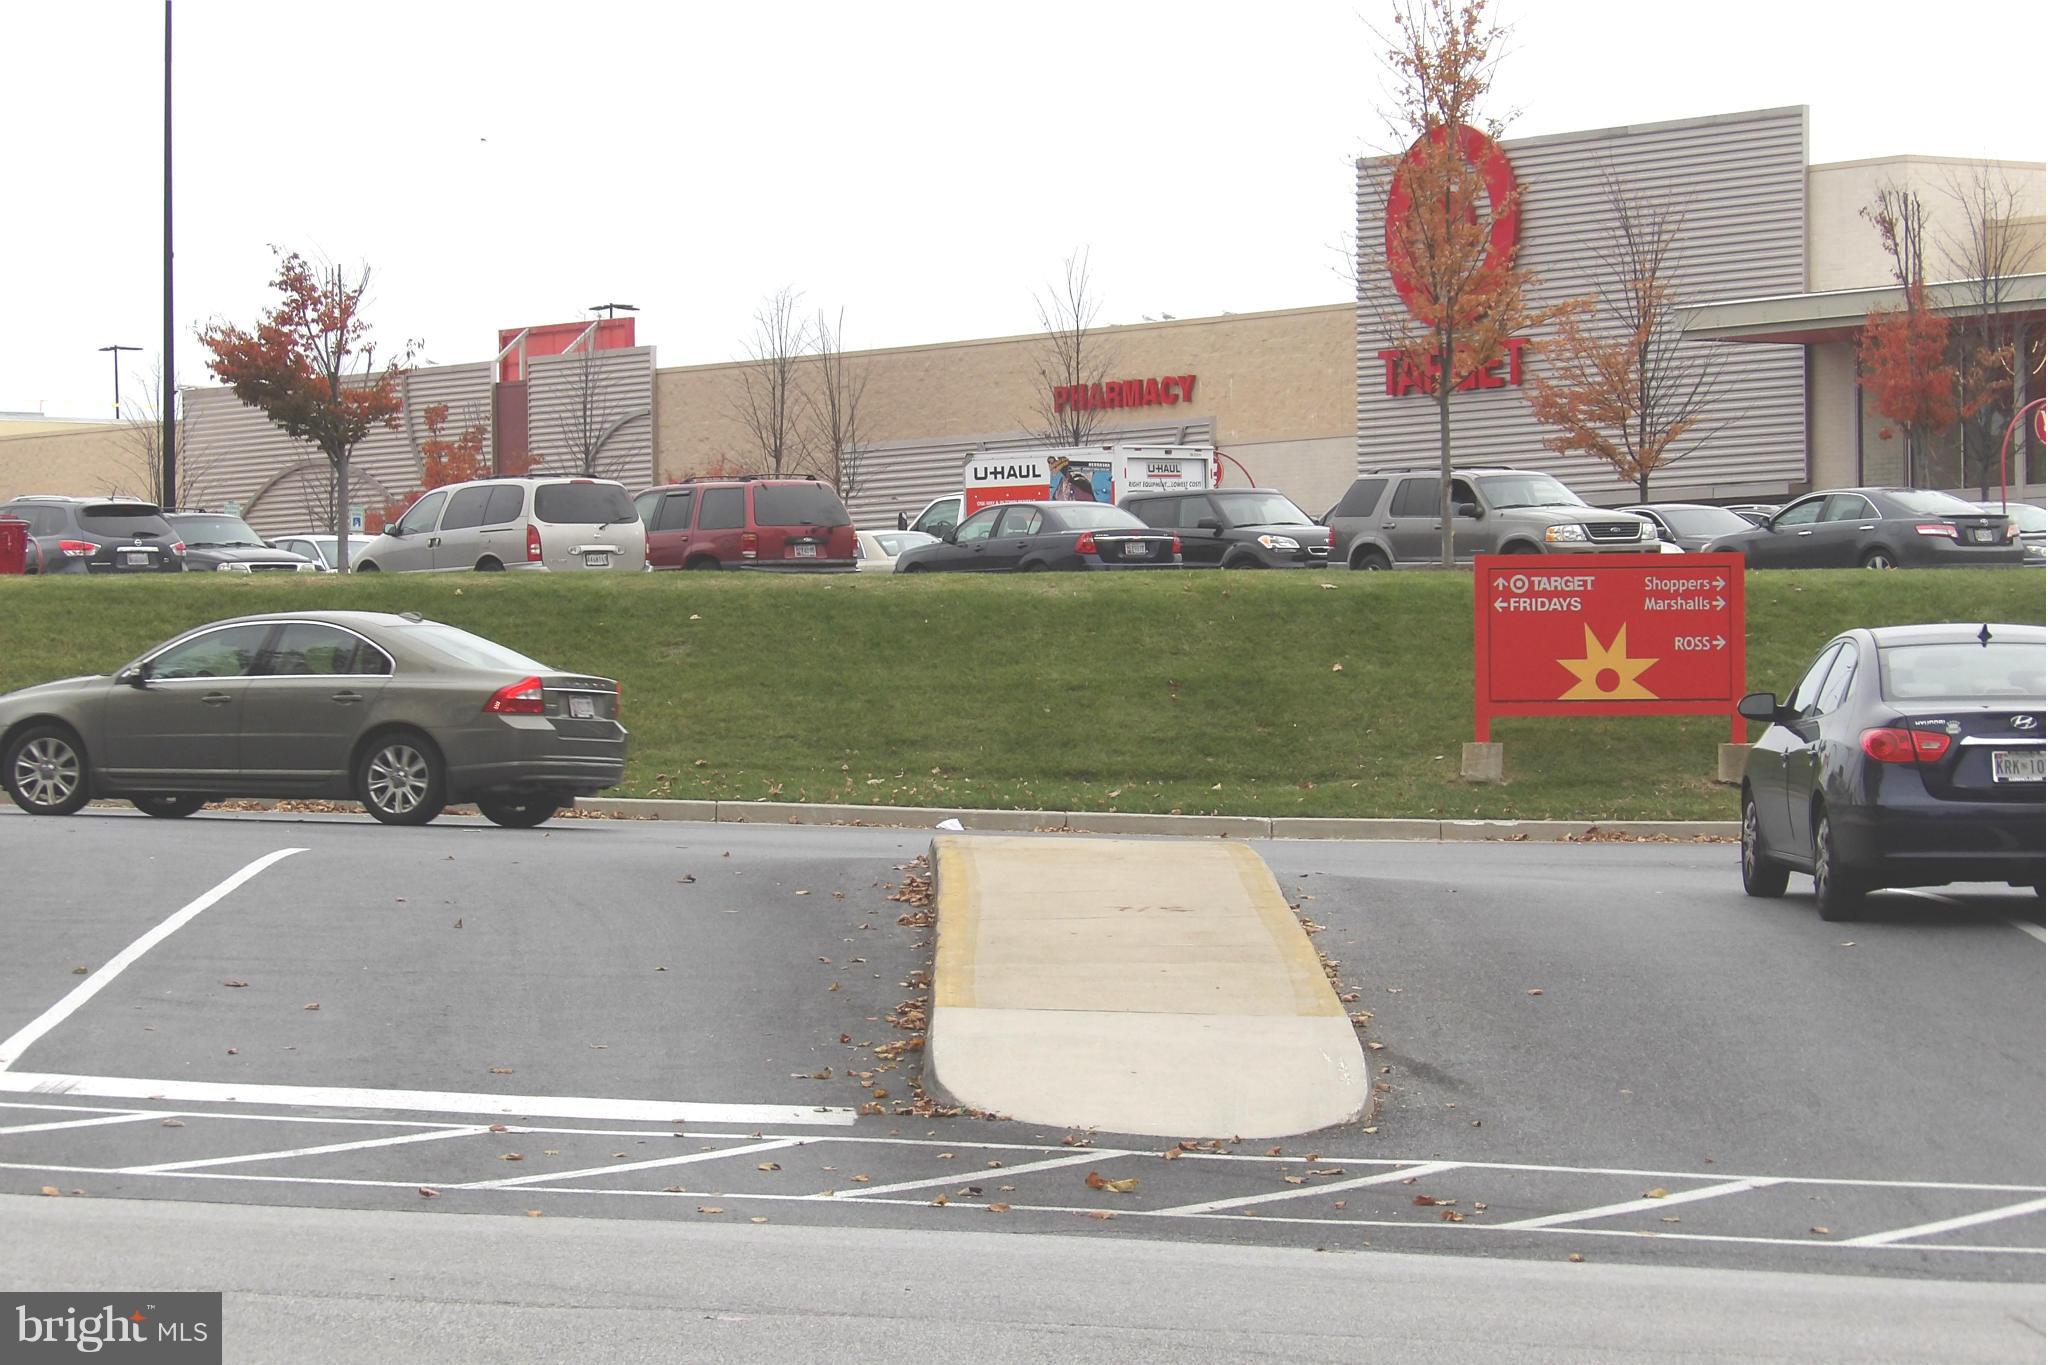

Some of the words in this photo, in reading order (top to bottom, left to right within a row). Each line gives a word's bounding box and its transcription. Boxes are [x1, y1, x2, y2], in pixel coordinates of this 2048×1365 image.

[1054, 374, 1197, 413] PHARMACY
[973, 464, 1041, 481] U-HAUL
[1147, 463, 1181, 473] U-HAUL
[1531, 576, 1595, 591] TARGET
[1644, 576, 1710, 594] Shoppers
[1509, 597, 1582, 611] FRIDAYS
[1644, 596, 1710, 611] Marshalls
[1674, 636, 1711, 650] ROSS
